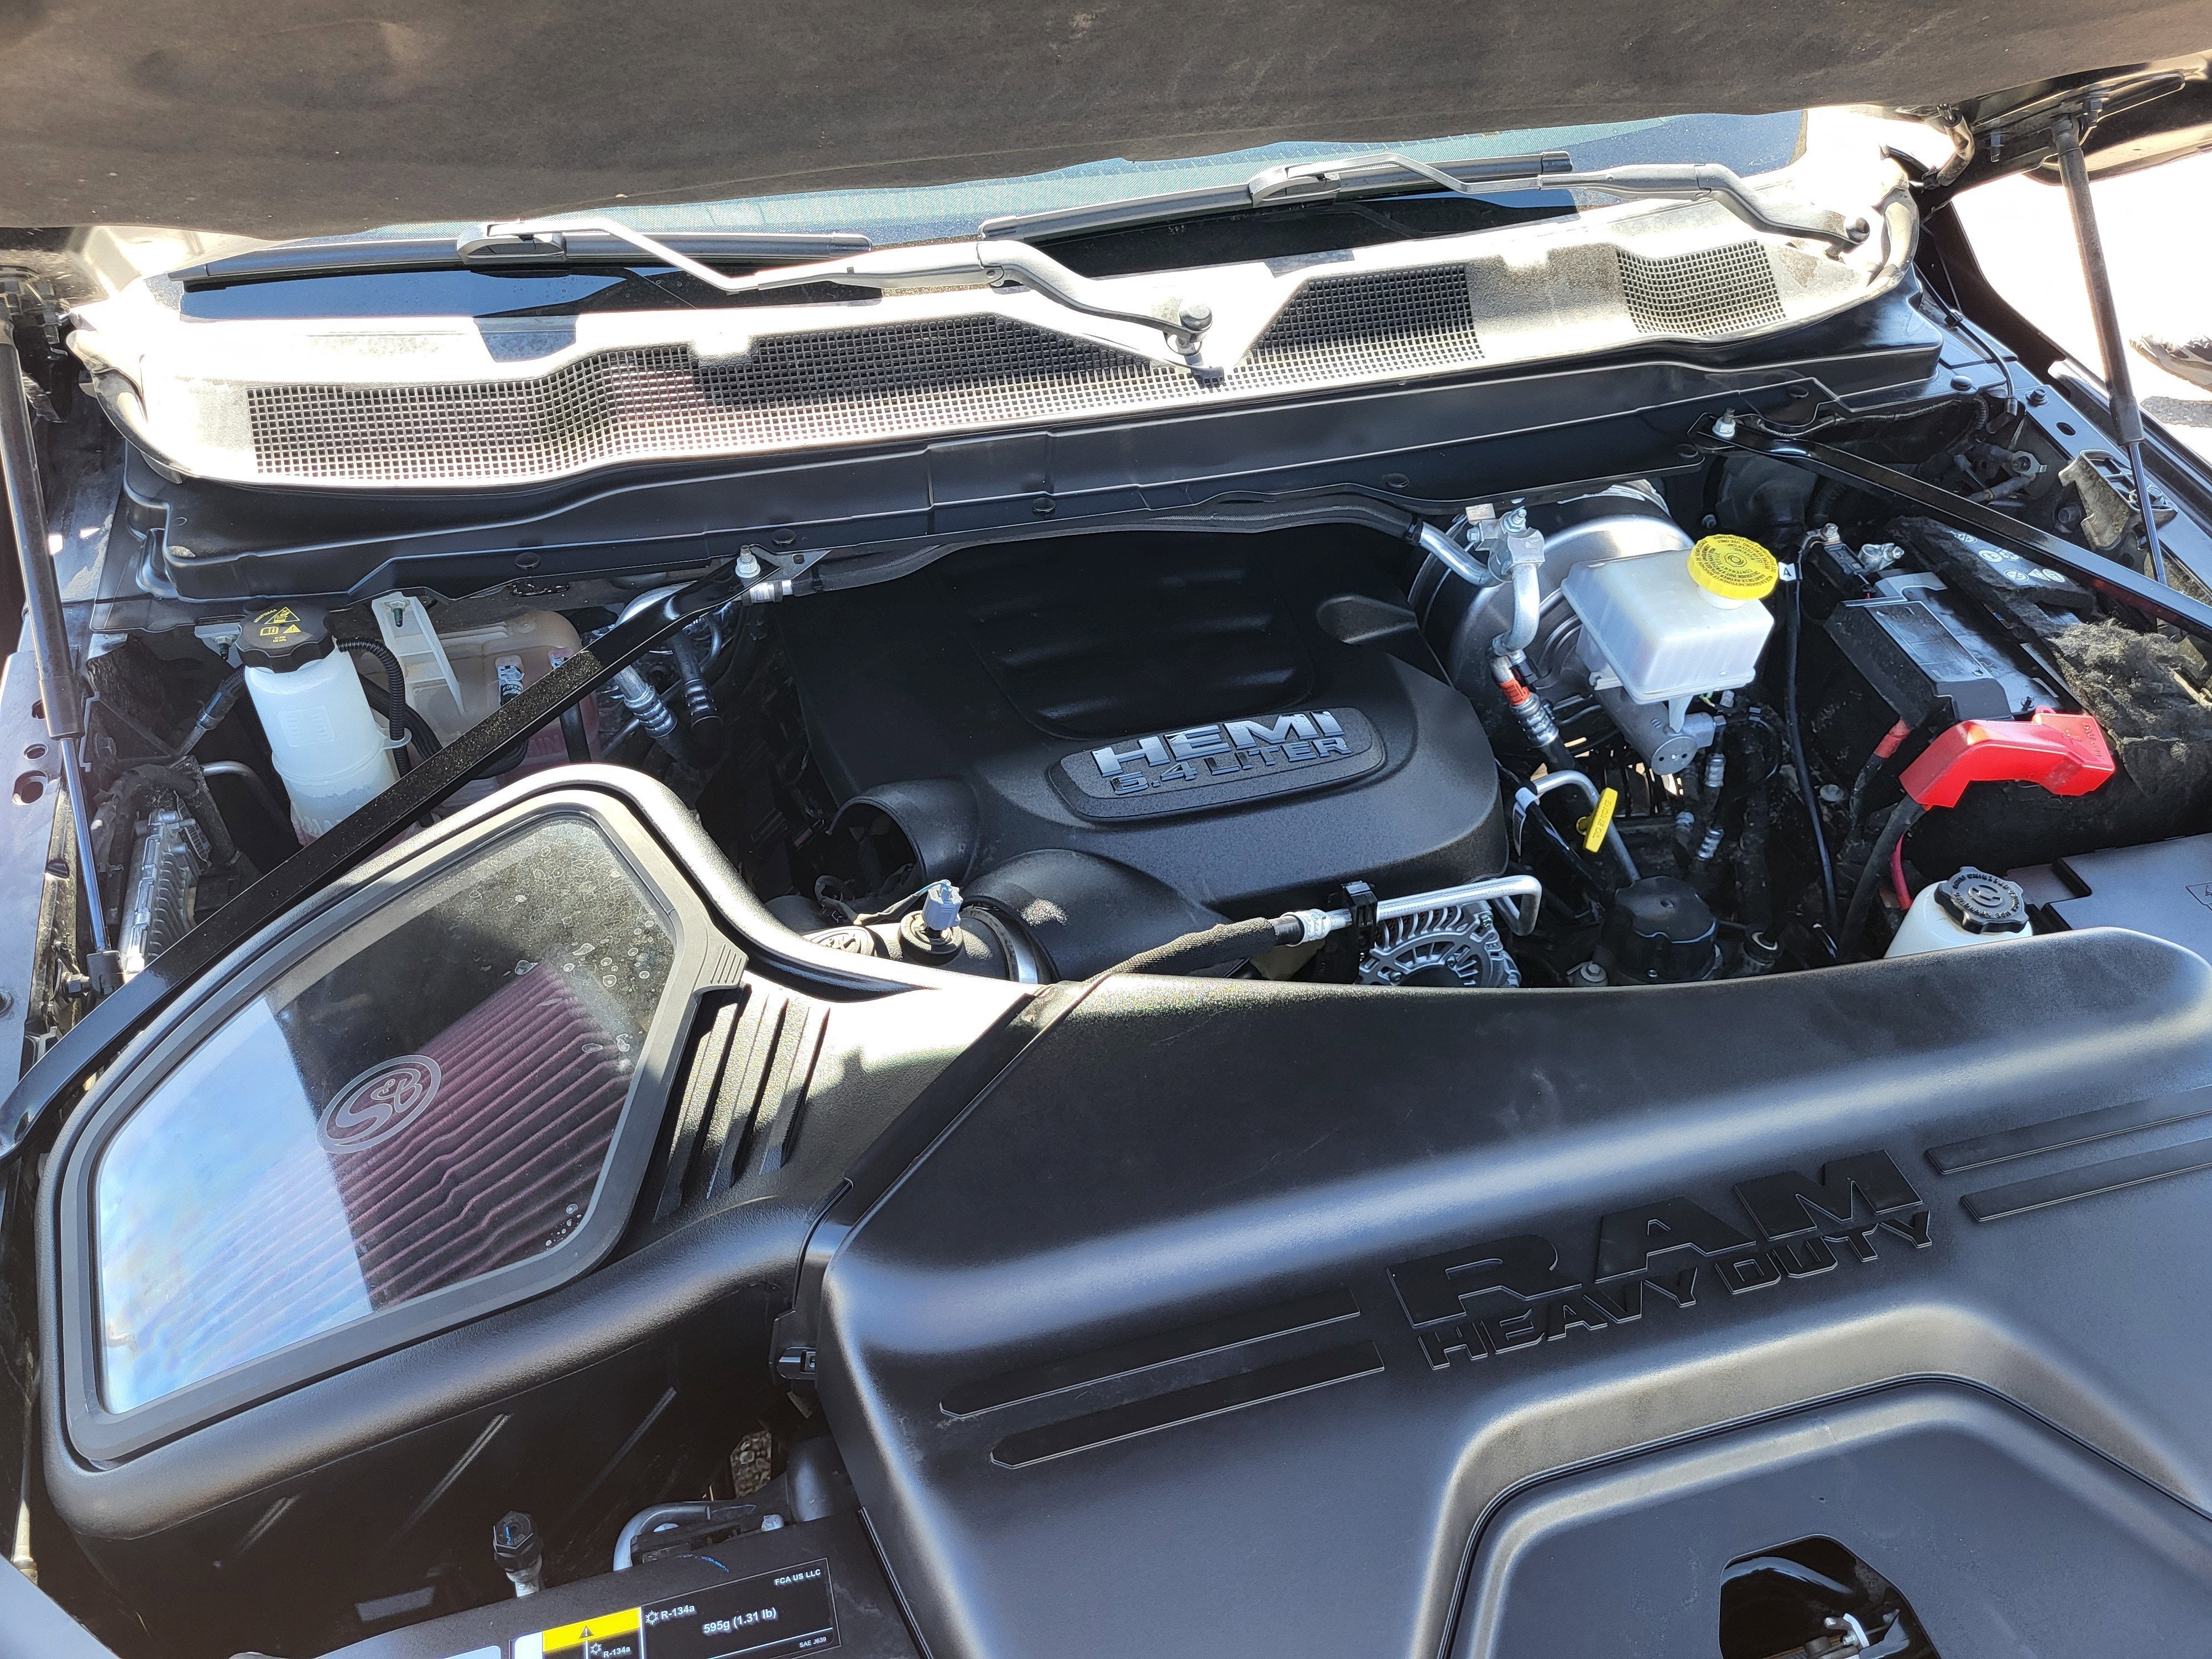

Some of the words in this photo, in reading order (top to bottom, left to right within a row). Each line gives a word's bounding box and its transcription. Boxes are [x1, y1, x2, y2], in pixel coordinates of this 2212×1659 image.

[1091, 710, 1347, 778] HEMI
[1110, 760, 1199, 795] 6.4
[1204, 736, 1353, 776] LITER
[334, 1068, 423, 1147] S&B
[1386, 1149, 1924, 1329] RAM
[1417, 1265, 1698, 1371] HEAVY
[1714, 1209, 1934, 1295] DUTY
[775, 1576, 792, 1585] FCA
[806, 1568, 821, 1578] LLC
[660, 1604, 696, 1620] R-134a
[703, 1620, 731, 1634] 595g
[733, 1611, 758, 1629] (1.31
[761, 1607, 777, 1619] lb)
[603, 1646, 630, 1658] R-134a
[799, 1640, 812, 1648] SAE
[813, 1637, 827, 1645] J639
